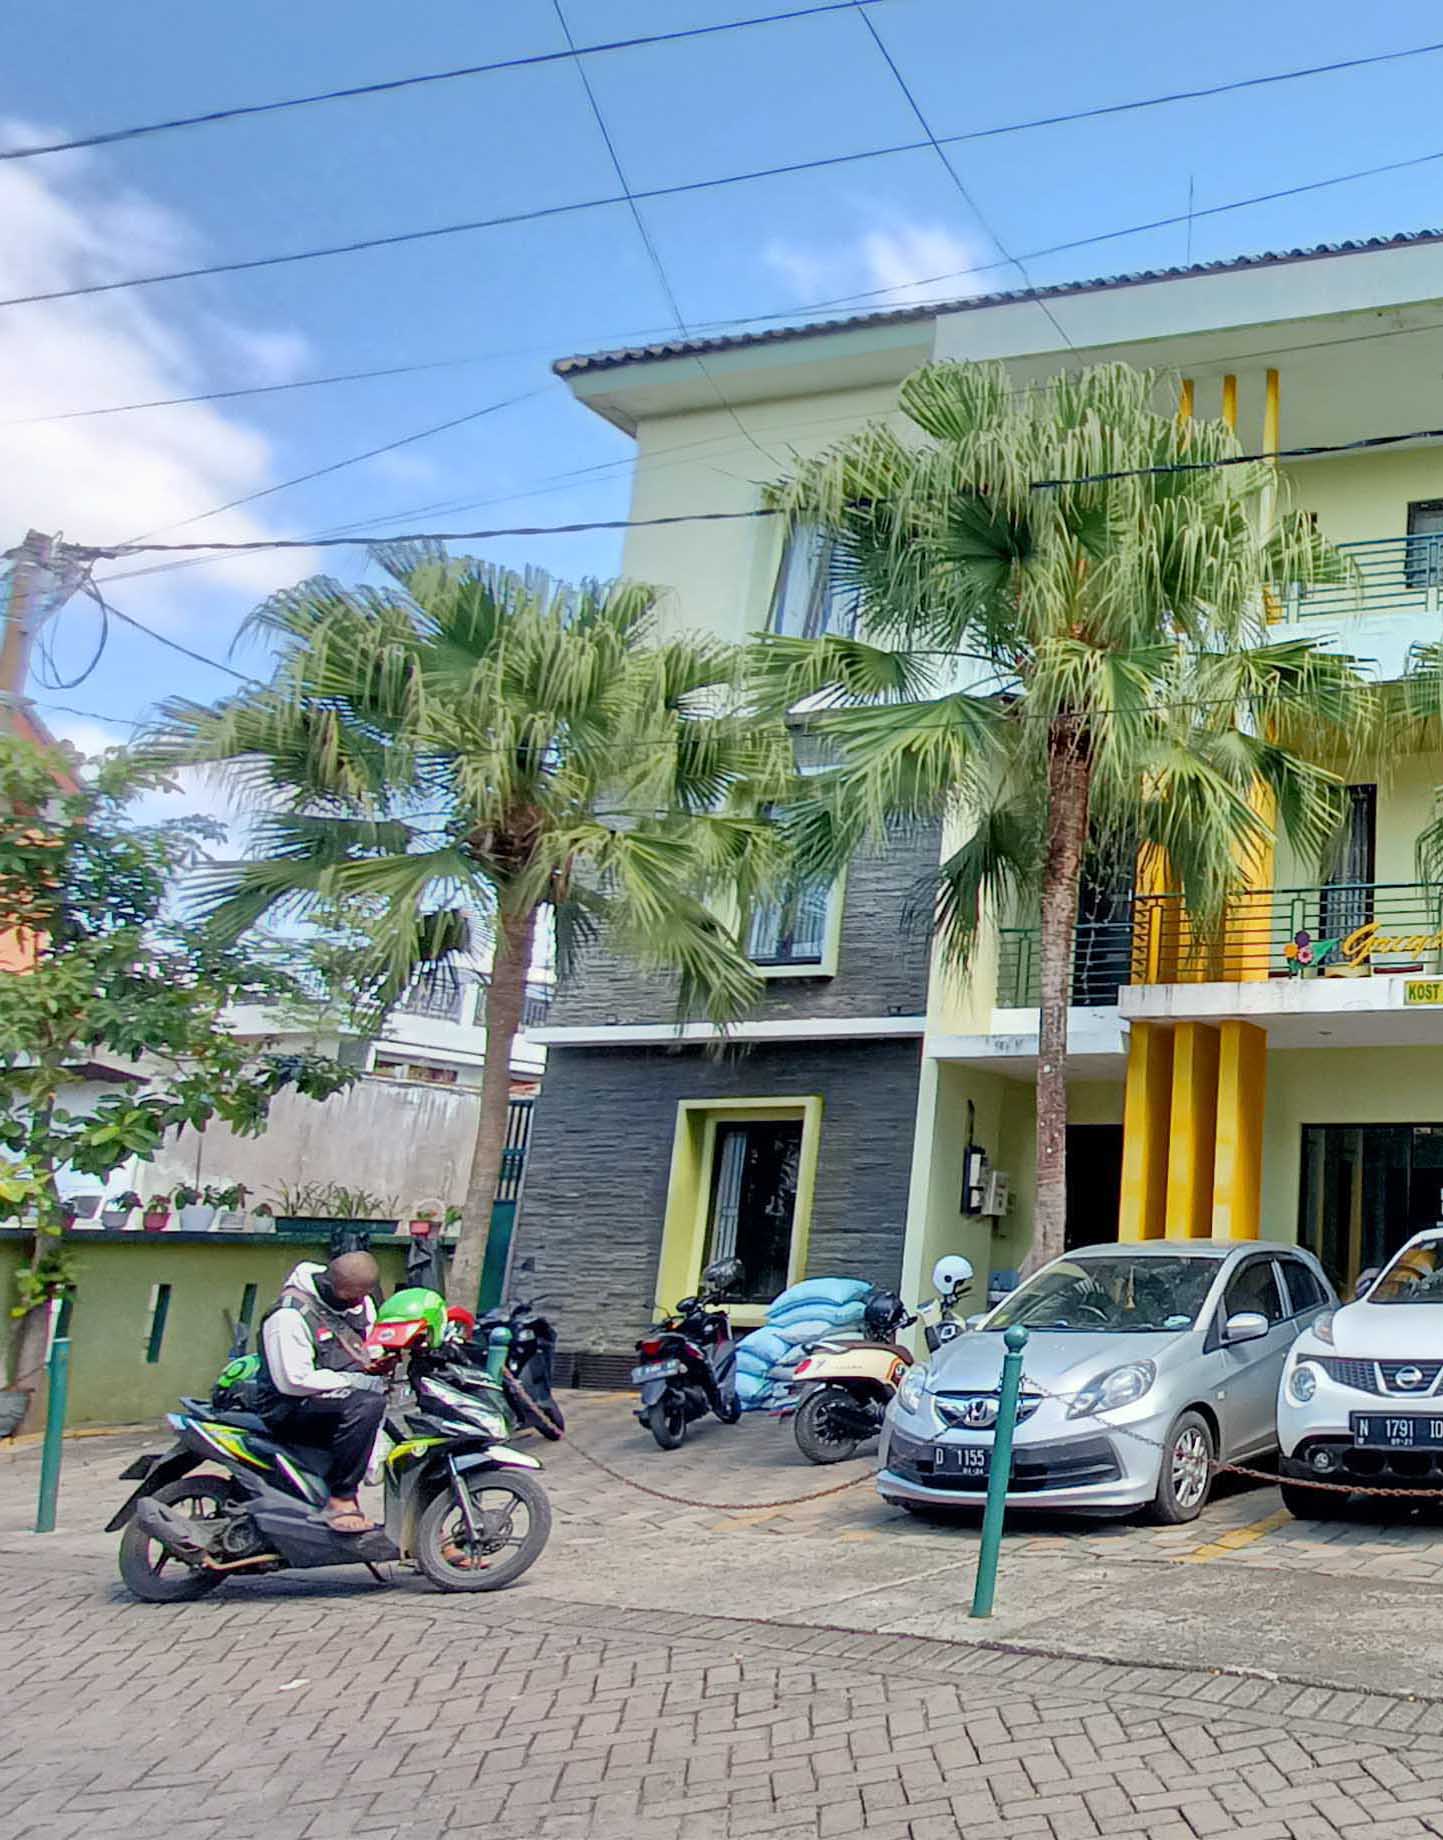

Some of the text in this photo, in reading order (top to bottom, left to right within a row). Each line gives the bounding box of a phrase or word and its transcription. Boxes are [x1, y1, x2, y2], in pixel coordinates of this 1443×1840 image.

[1408, 983, 1440, 1001] KOST
[1359, 1418, 1370, 1438] N
[1386, 1419, 1414, 1439] 1791
[935, 1447, 985, 1467] D 1155
